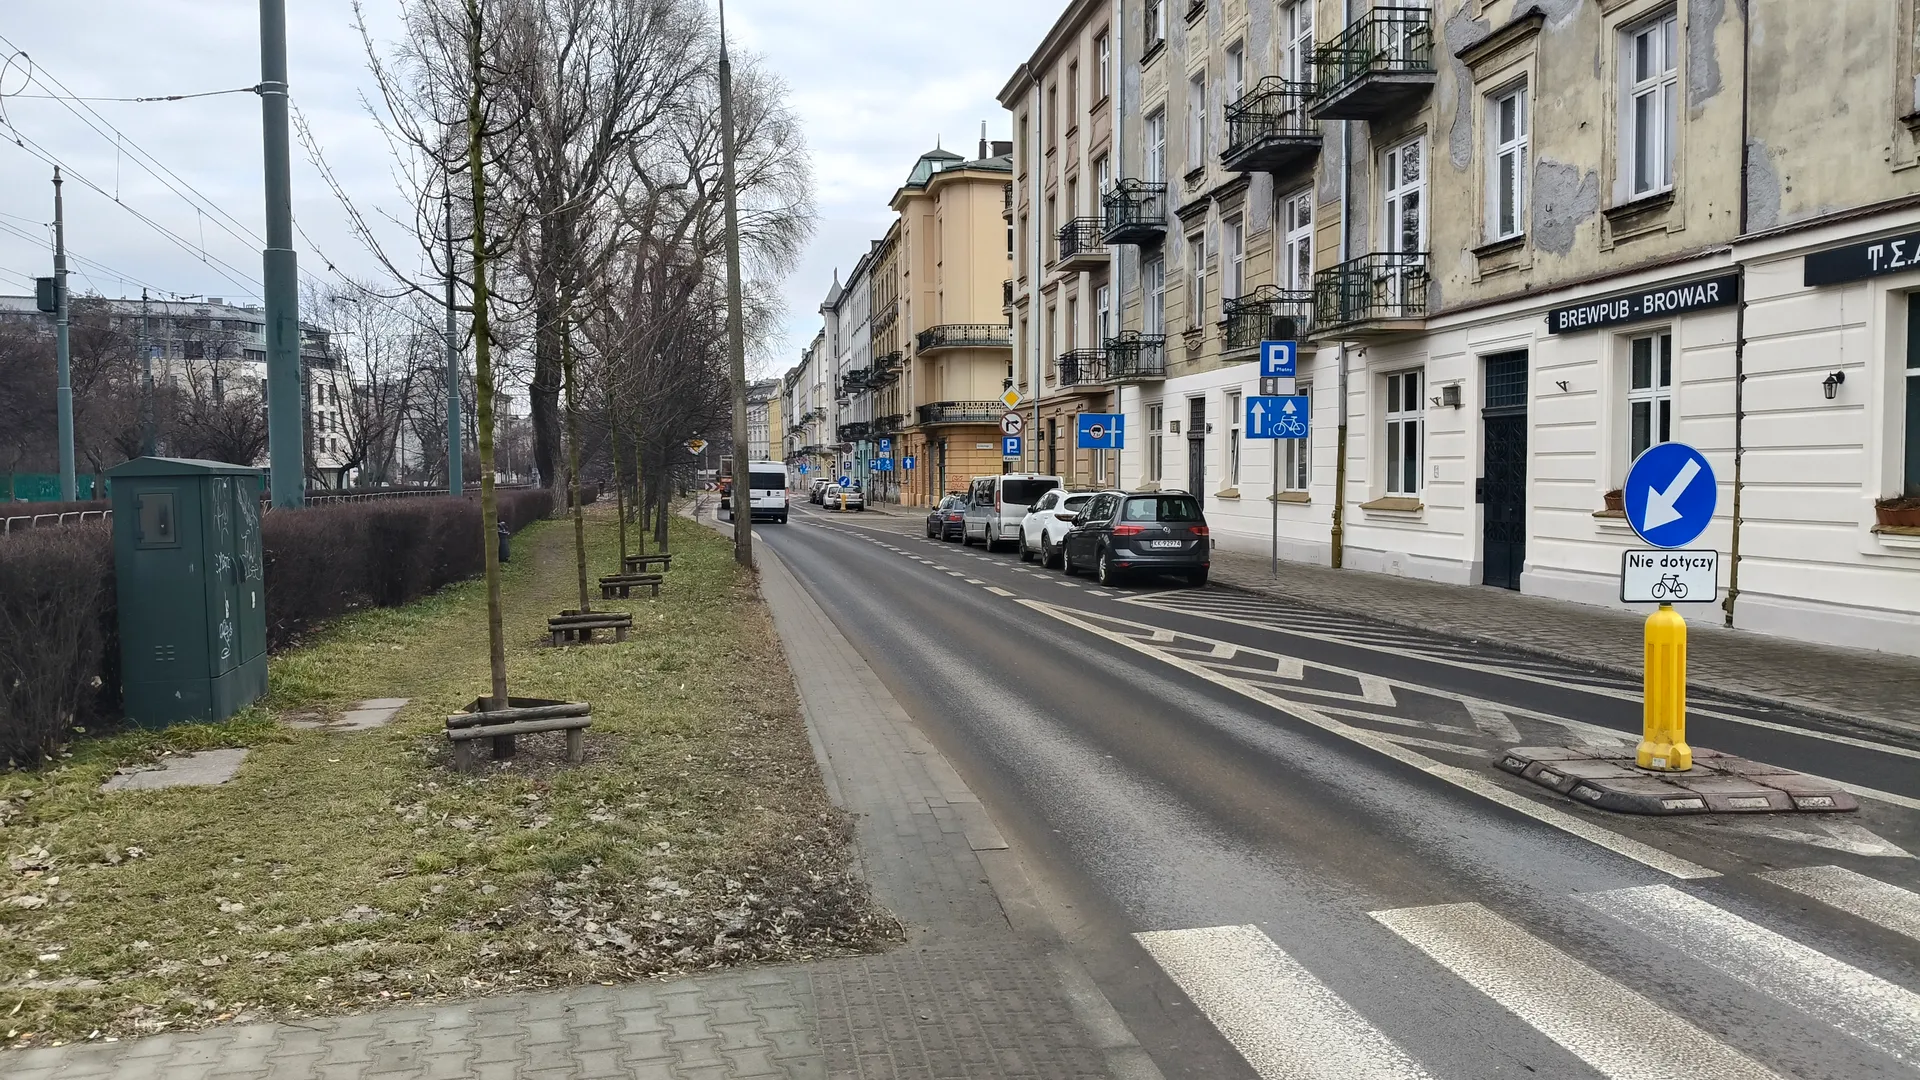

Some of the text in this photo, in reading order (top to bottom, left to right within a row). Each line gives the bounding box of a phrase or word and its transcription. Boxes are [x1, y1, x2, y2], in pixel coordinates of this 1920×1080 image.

[1559, 299, 1630, 329] BREWPUB
[1643, 282, 1719, 314] BROWAR
[1268, 344, 1289, 373] P
[1006, 438, 1018, 454] P
[1629, 554, 1714, 572] Nie dotyczy
